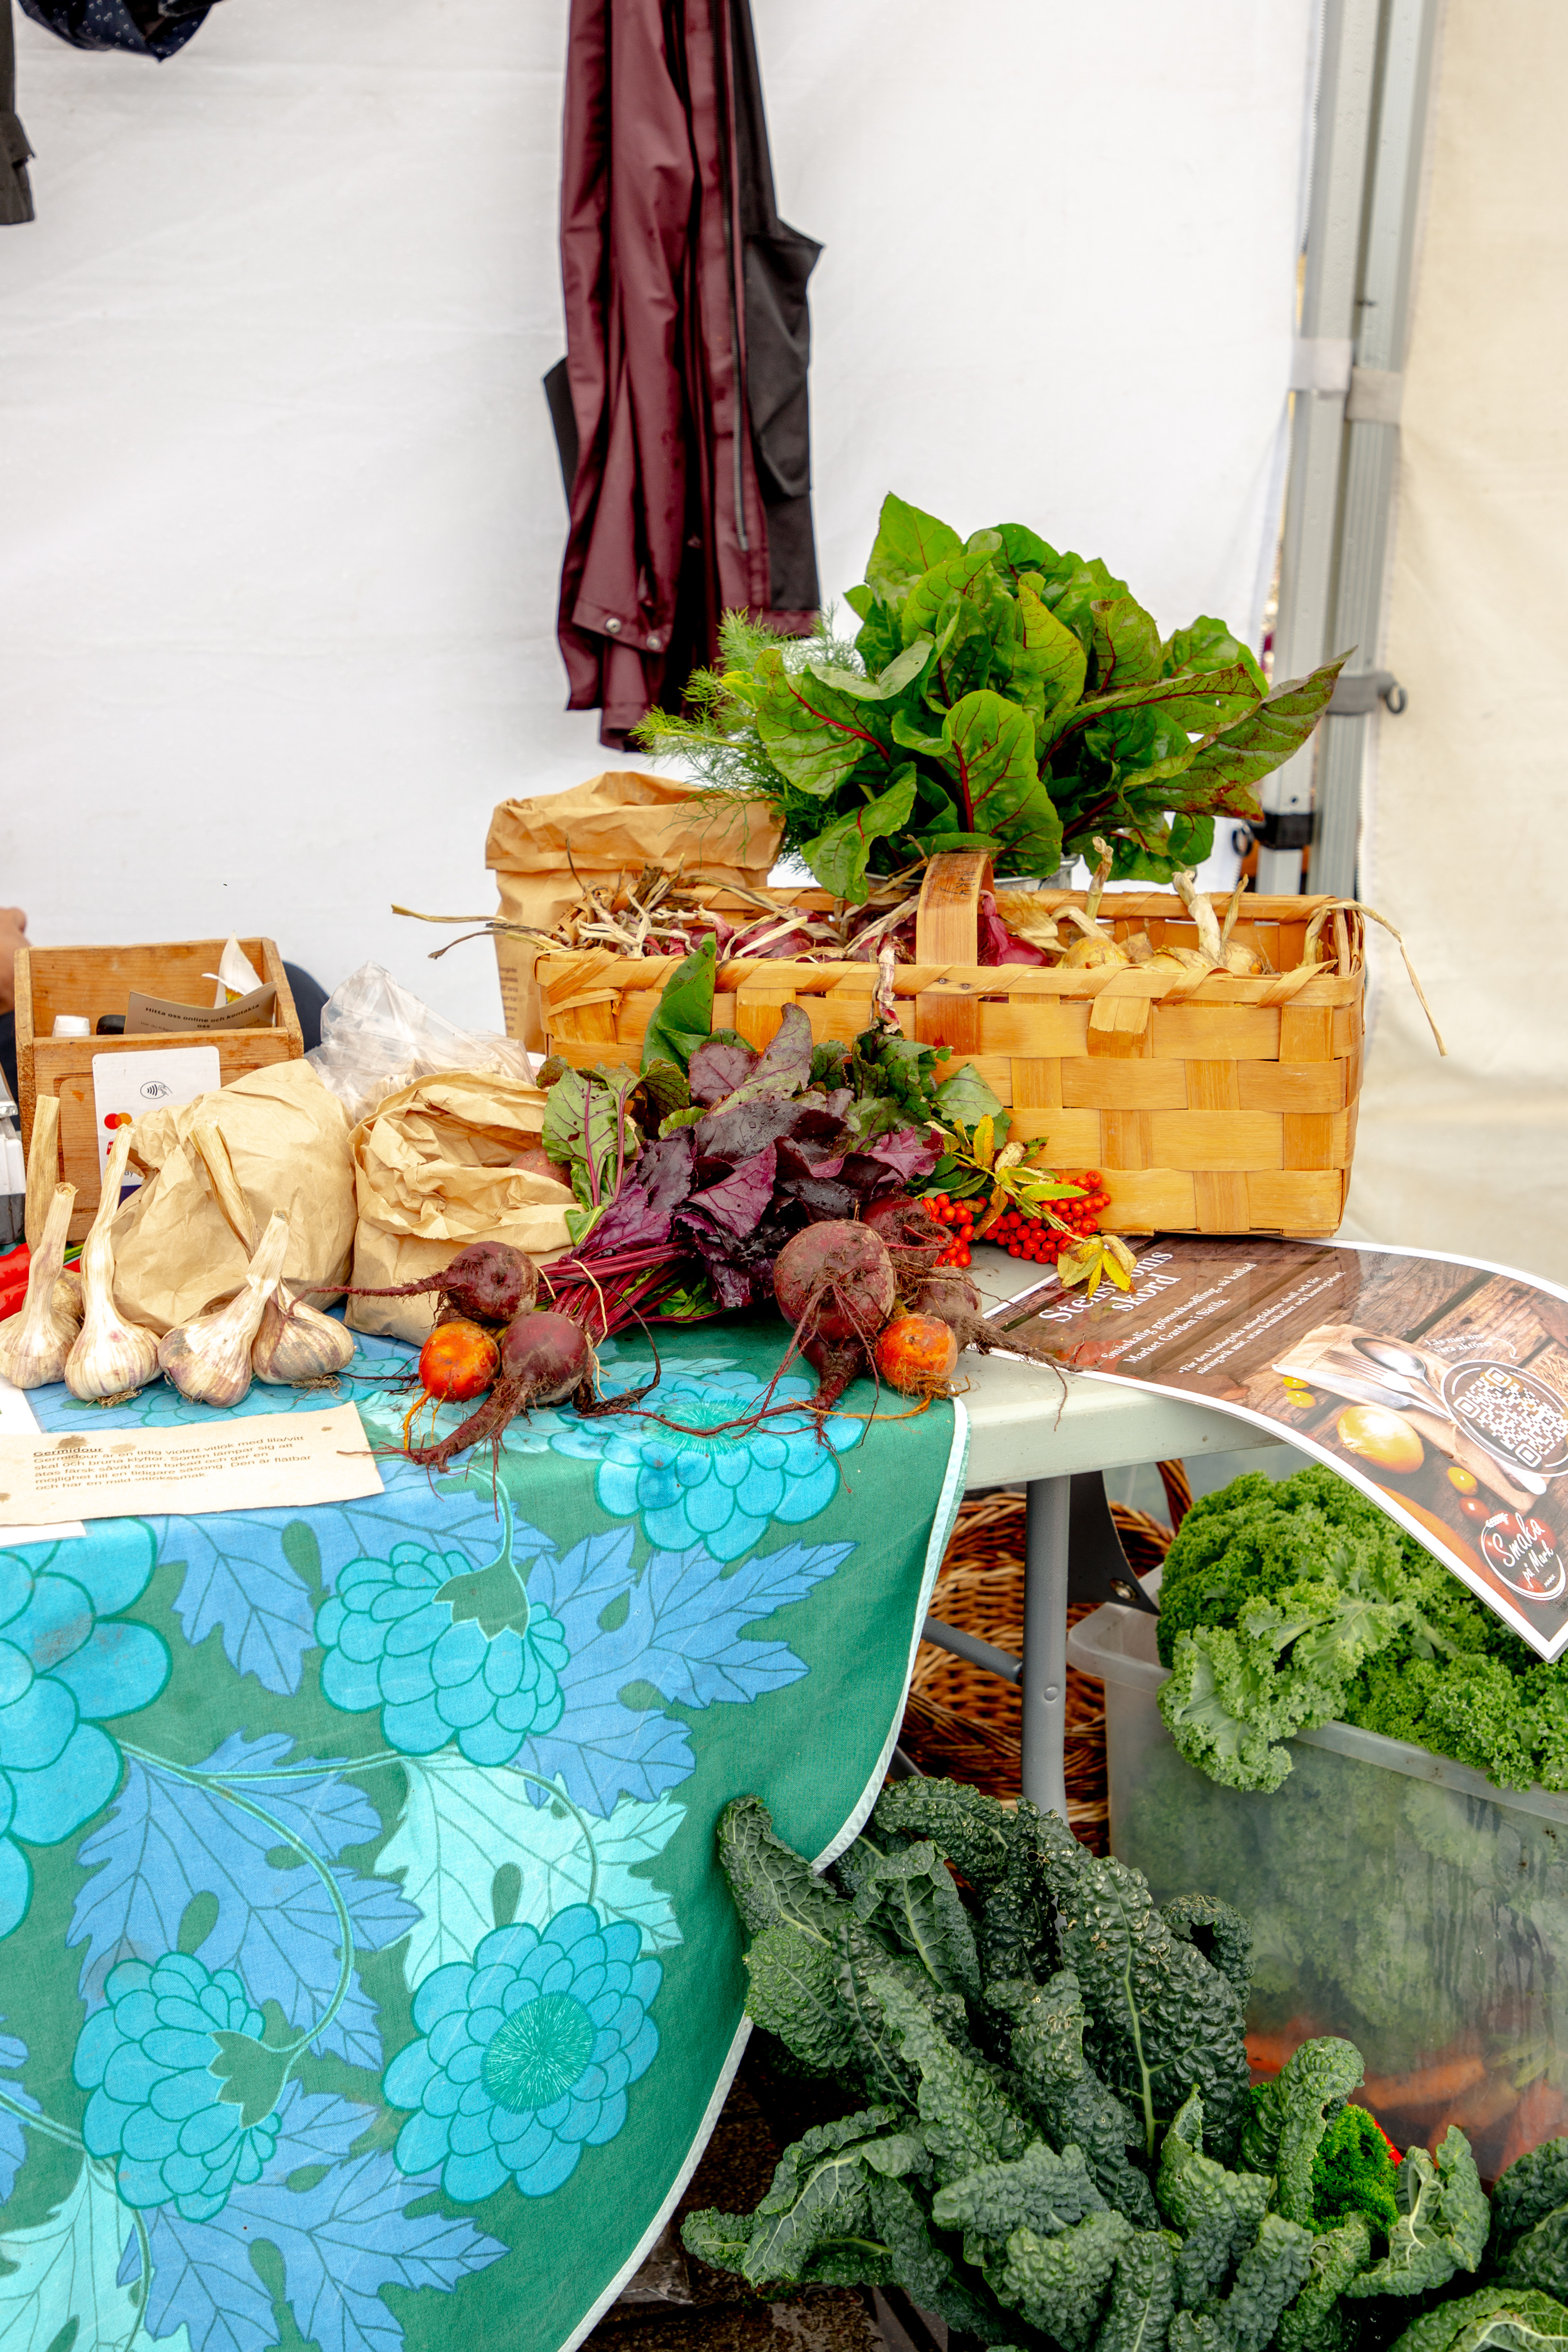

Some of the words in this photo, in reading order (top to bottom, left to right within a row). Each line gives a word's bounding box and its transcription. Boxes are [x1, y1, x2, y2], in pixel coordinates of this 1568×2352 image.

[146, 1007, 165, 1015] Hitta
[227, 1004, 259, 1019] kontakta
[1101, 1329, 1158, 1359] Småskalig
[1151, 1287, 1223, 1330] grönsaksodling,
[1224, 1263, 1258, 1280] kallad
[1123, 1341, 1164, 1363] Market
[1158, 1319, 1198, 1341] Garden
[1196, 1299, 1231, 1316] Sätila.
[1194, 1353, 1212, 1362] den
[1205, 1330, 1246, 1353] biologiska
[1242, 1303, 1285, 1330] mångfaldens
[1281, 1291, 1301, 1303] skull
[1297, 1284, 1312, 1292] och
[1197, 1350, 1234, 1374] näringsrik
[1231, 1340, 1251, 1350] mat,
[1246, 1328, 1265, 1339] utan
[1258, 1305, 1297, 1328] kemikalier
[1295, 1297, 1310, 1306] och
[1303, 1272, 1346, 1297] konstgödsel.
[1457, 1341, 1493, 1350] aktörer
[33, 1448, 103, 1456] Germidour
[34, 1454, 98, 1463] Germidour
[204, 1443, 234, 1451] vitlök
[213, 1447, 253, 1456] lämpar
[35, 1475, 90, 1484] möjlighet
[179, 1464, 226, 1473] säsong.
[135, 1472, 209, 1481] vitlökssmak.
[1492, 1512, 1545, 1567] Smaka
[1528, 1539, 1554, 1573] Mark
[1522, 1563, 1535, 1588] på
[1544, 1574, 1556, 1587] MARK
